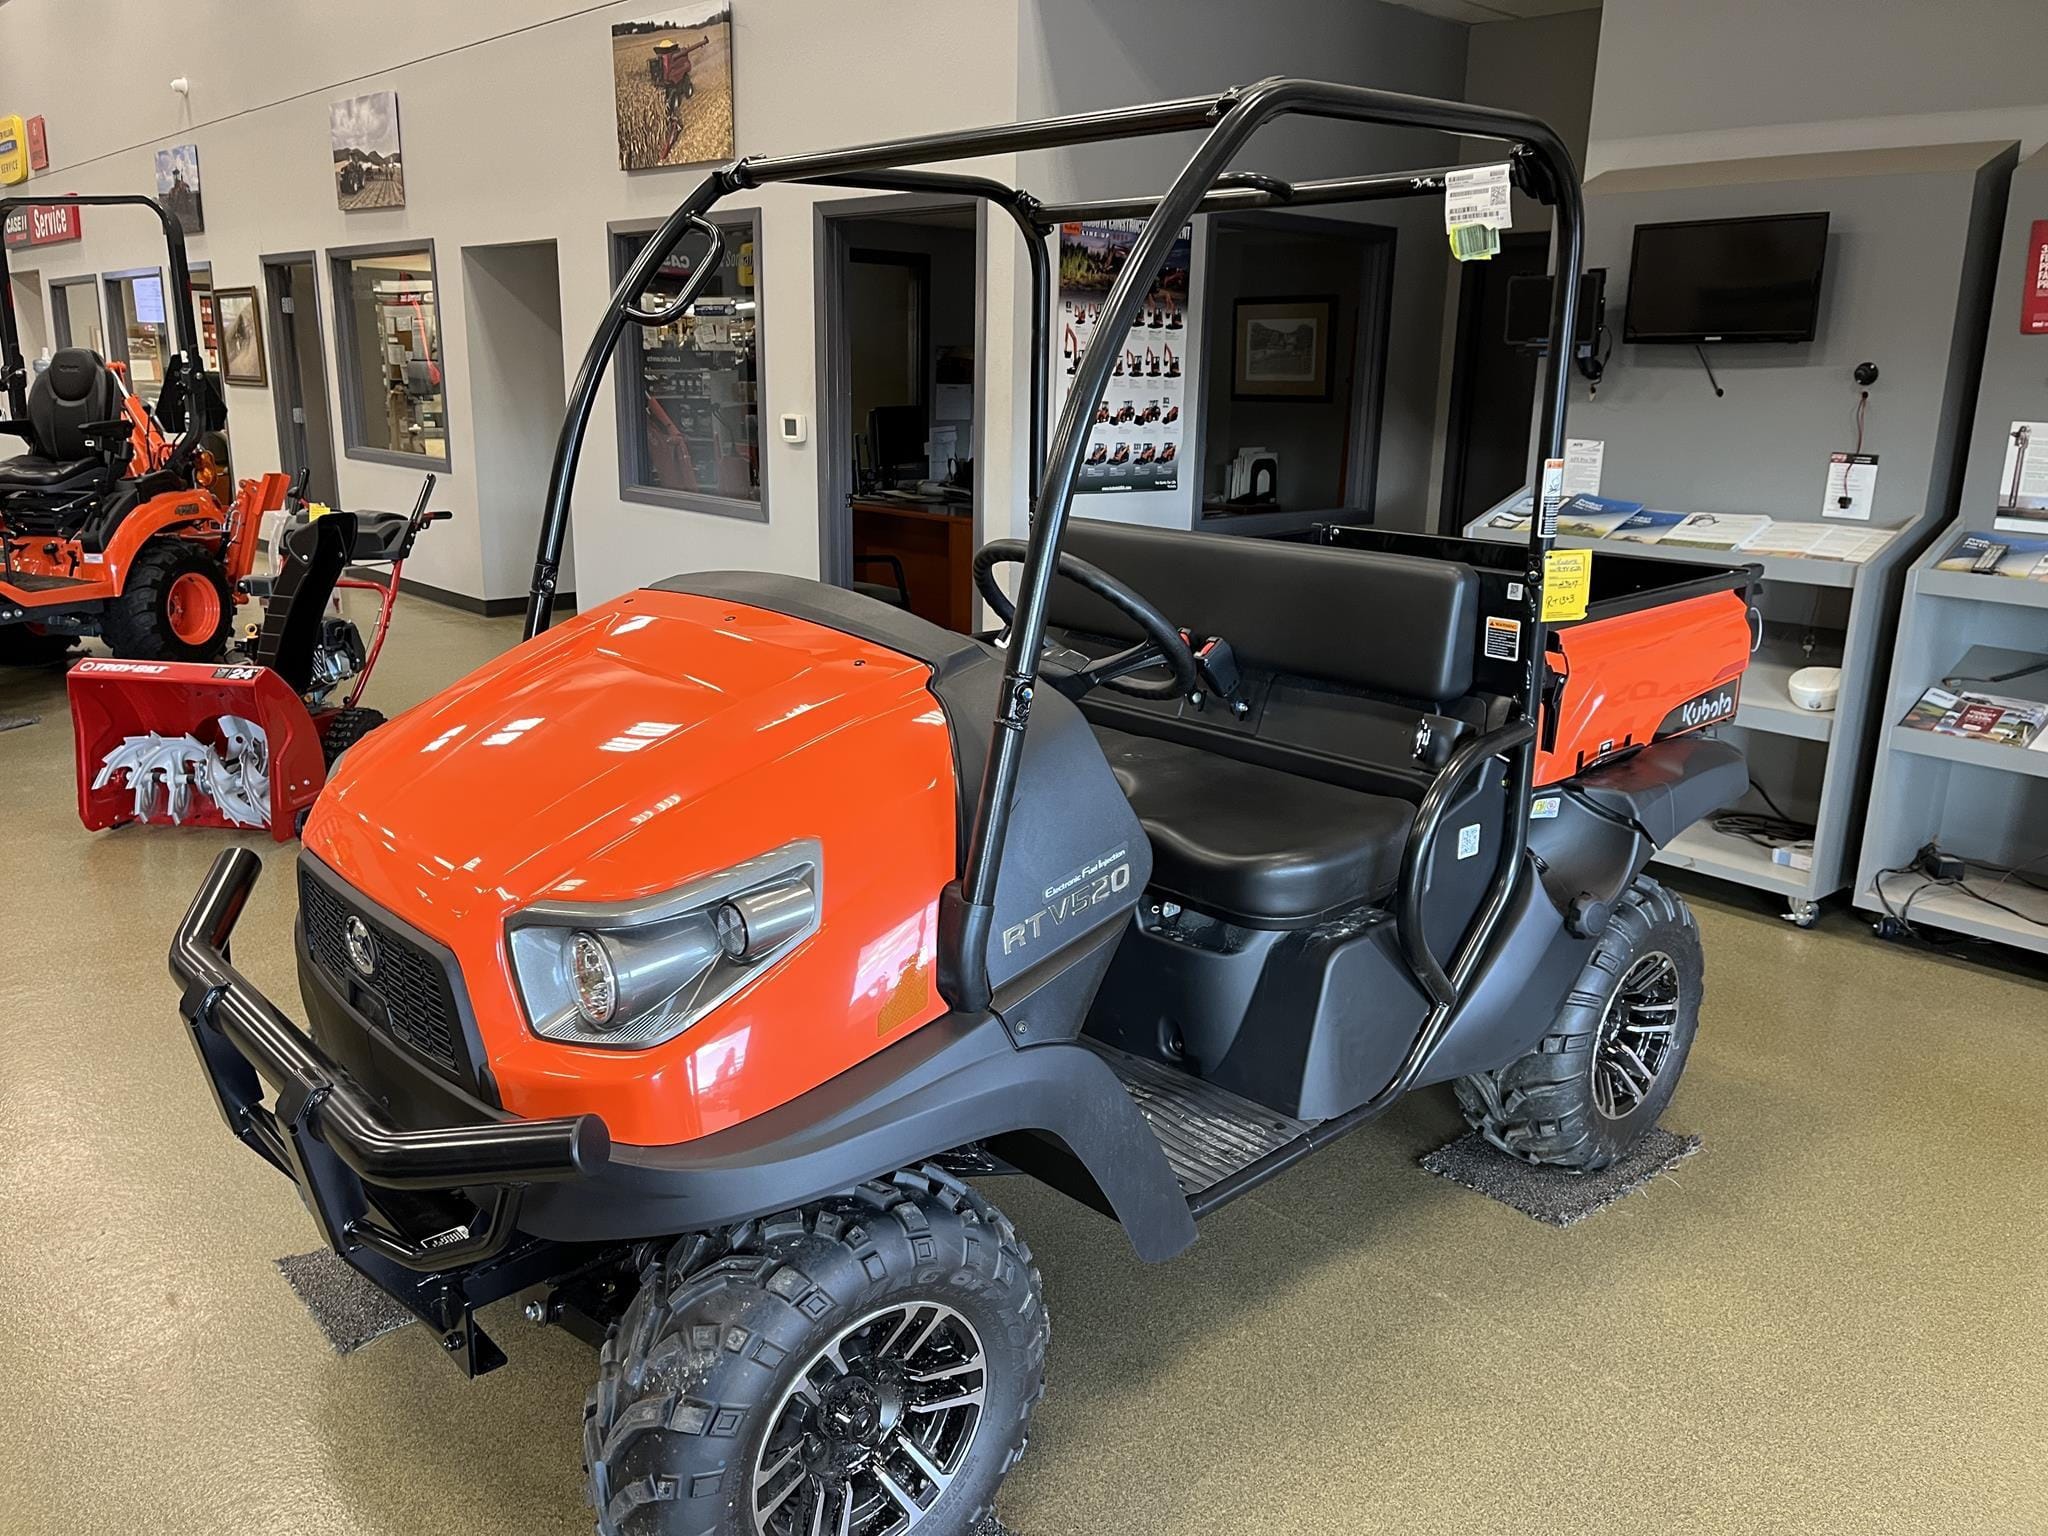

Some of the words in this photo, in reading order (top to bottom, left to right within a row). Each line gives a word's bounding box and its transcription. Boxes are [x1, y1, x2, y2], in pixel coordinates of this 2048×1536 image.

[33, 206, 67, 239] Service
[93, 661, 170, 675] TROY-BILT
[1682, 692, 1733, 726] Kubota
[1045, 874, 1082, 899] Electronic
[1081, 864, 1099, 879] Fuel
[1098, 849, 1126, 870] Injection
